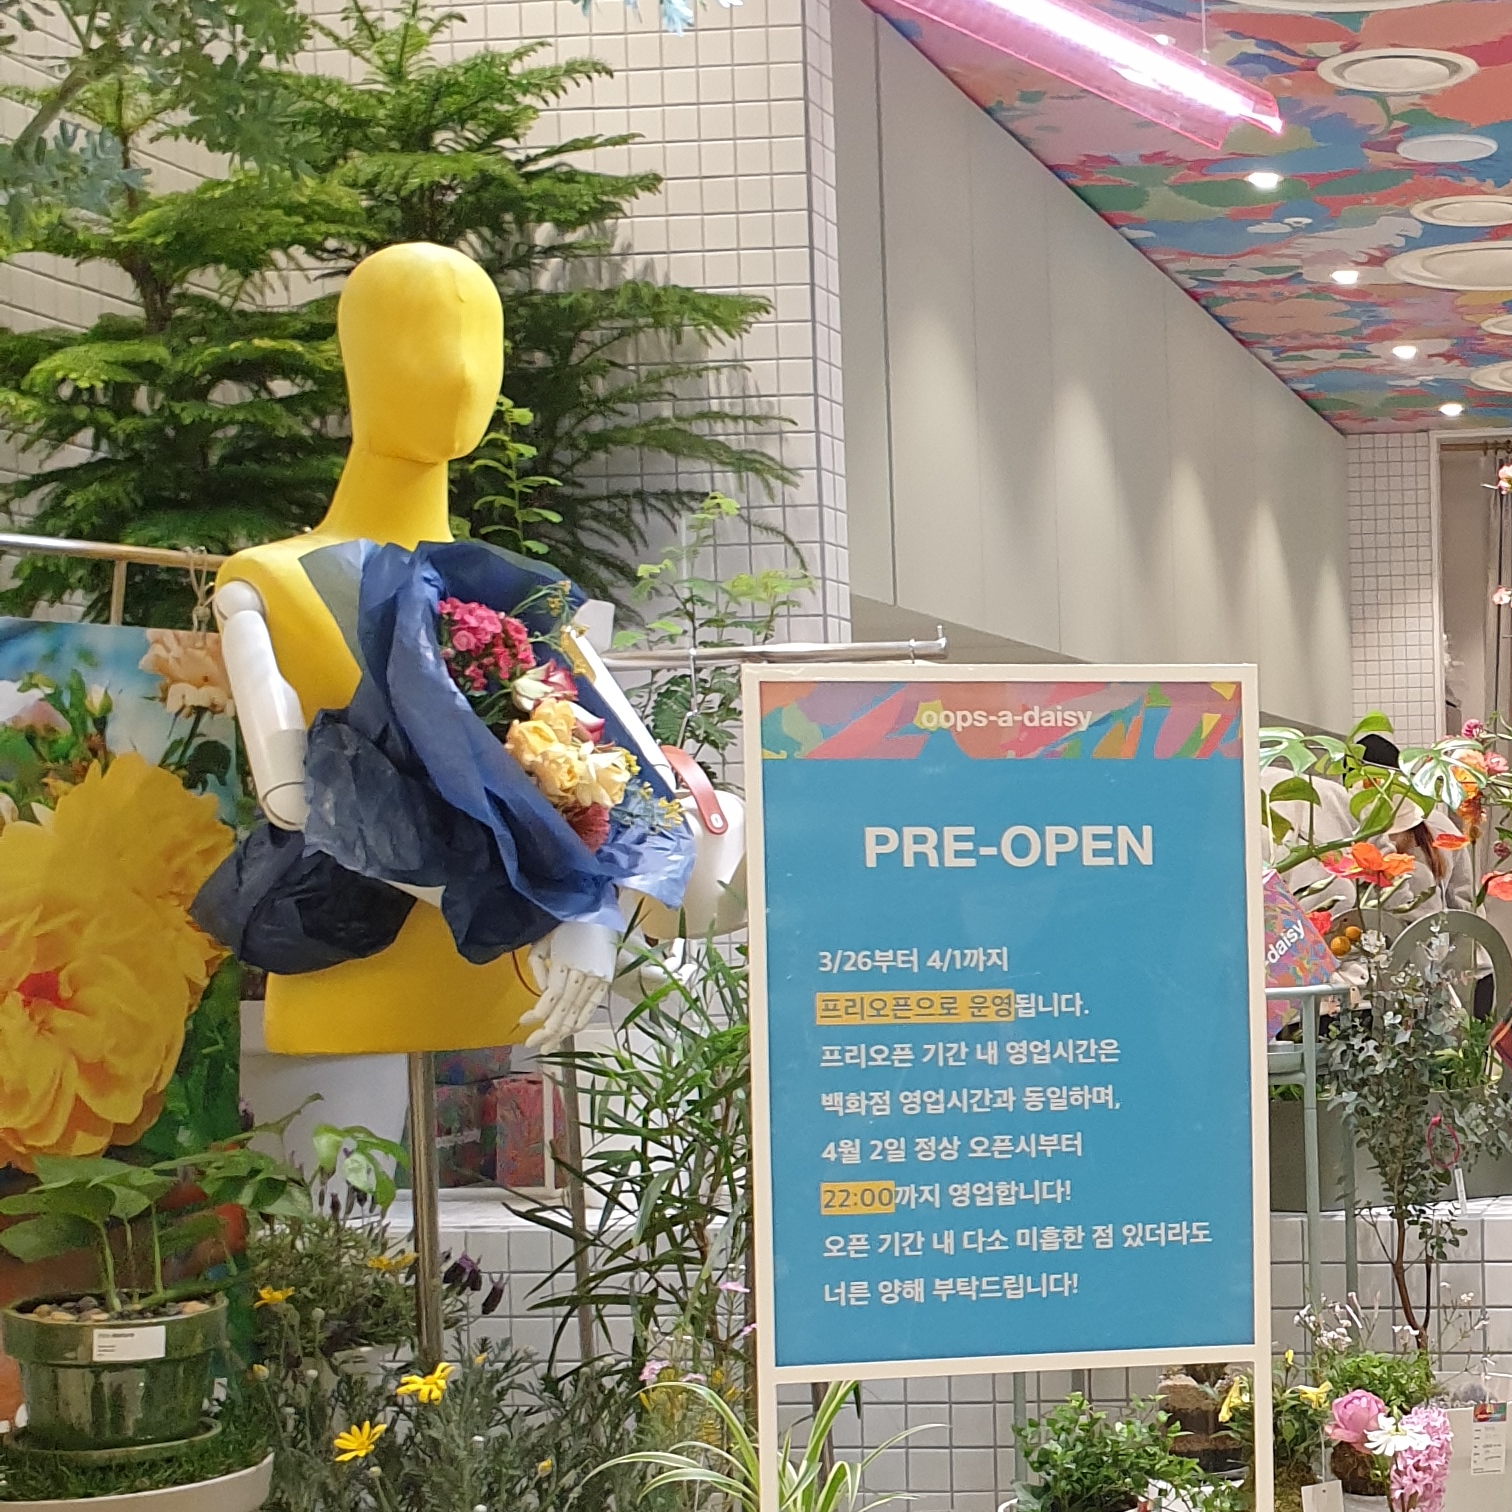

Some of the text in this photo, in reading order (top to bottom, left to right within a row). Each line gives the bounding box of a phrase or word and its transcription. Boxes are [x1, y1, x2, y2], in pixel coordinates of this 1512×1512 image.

[919, 705, 1093, 732] oops-a-daisy
[863, 824, 1154, 868] PRE-OPEN
[818, 946, 1009, 974] 3/26부터 4/1까지
[819, 991, 1090, 1021] 프리오픈으로 운영됩니다.
[820, 1038, 1122, 1069] 프리오픈 기간 내 영업시간은
[821, 1084, 1121, 1117] 백화점 영업시간과 동일하며,
[821, 1131, 1083, 1165] 4월 2일 정상 오픈시부터
[823, 1178, 1072, 1210] 22:00까지 영업합니다!
[823, 1220, 1213, 1258] 오픈 기간 내 다소 미흡한 점 있더라도
[824, 1271, 1079, 1307] 너른 양해 부탁드립니다!
